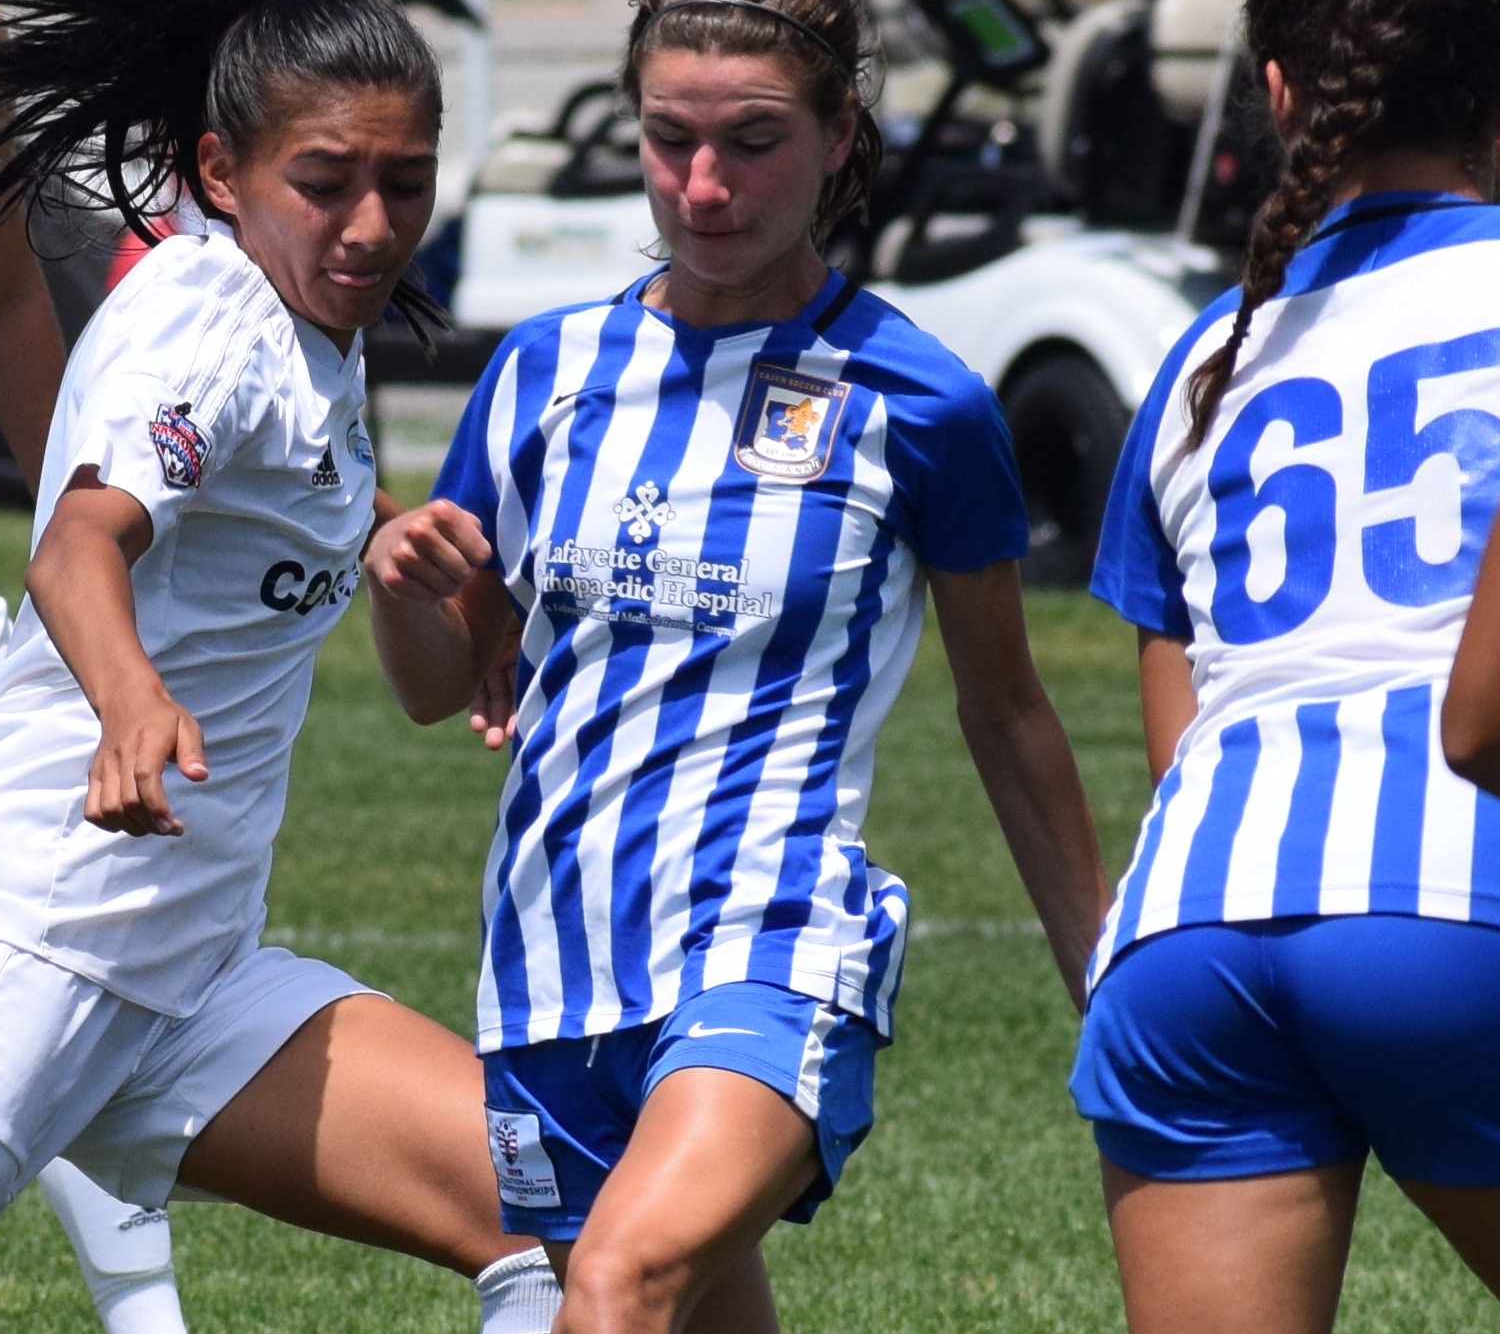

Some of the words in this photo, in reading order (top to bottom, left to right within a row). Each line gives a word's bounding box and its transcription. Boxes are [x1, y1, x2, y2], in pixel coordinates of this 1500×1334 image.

[544, 538, 642, 573] Lafayette
[646, 548, 750, 586] General
[538, 566, 655, 602] thopaedic
[660, 579, 772, 619] Hospital
